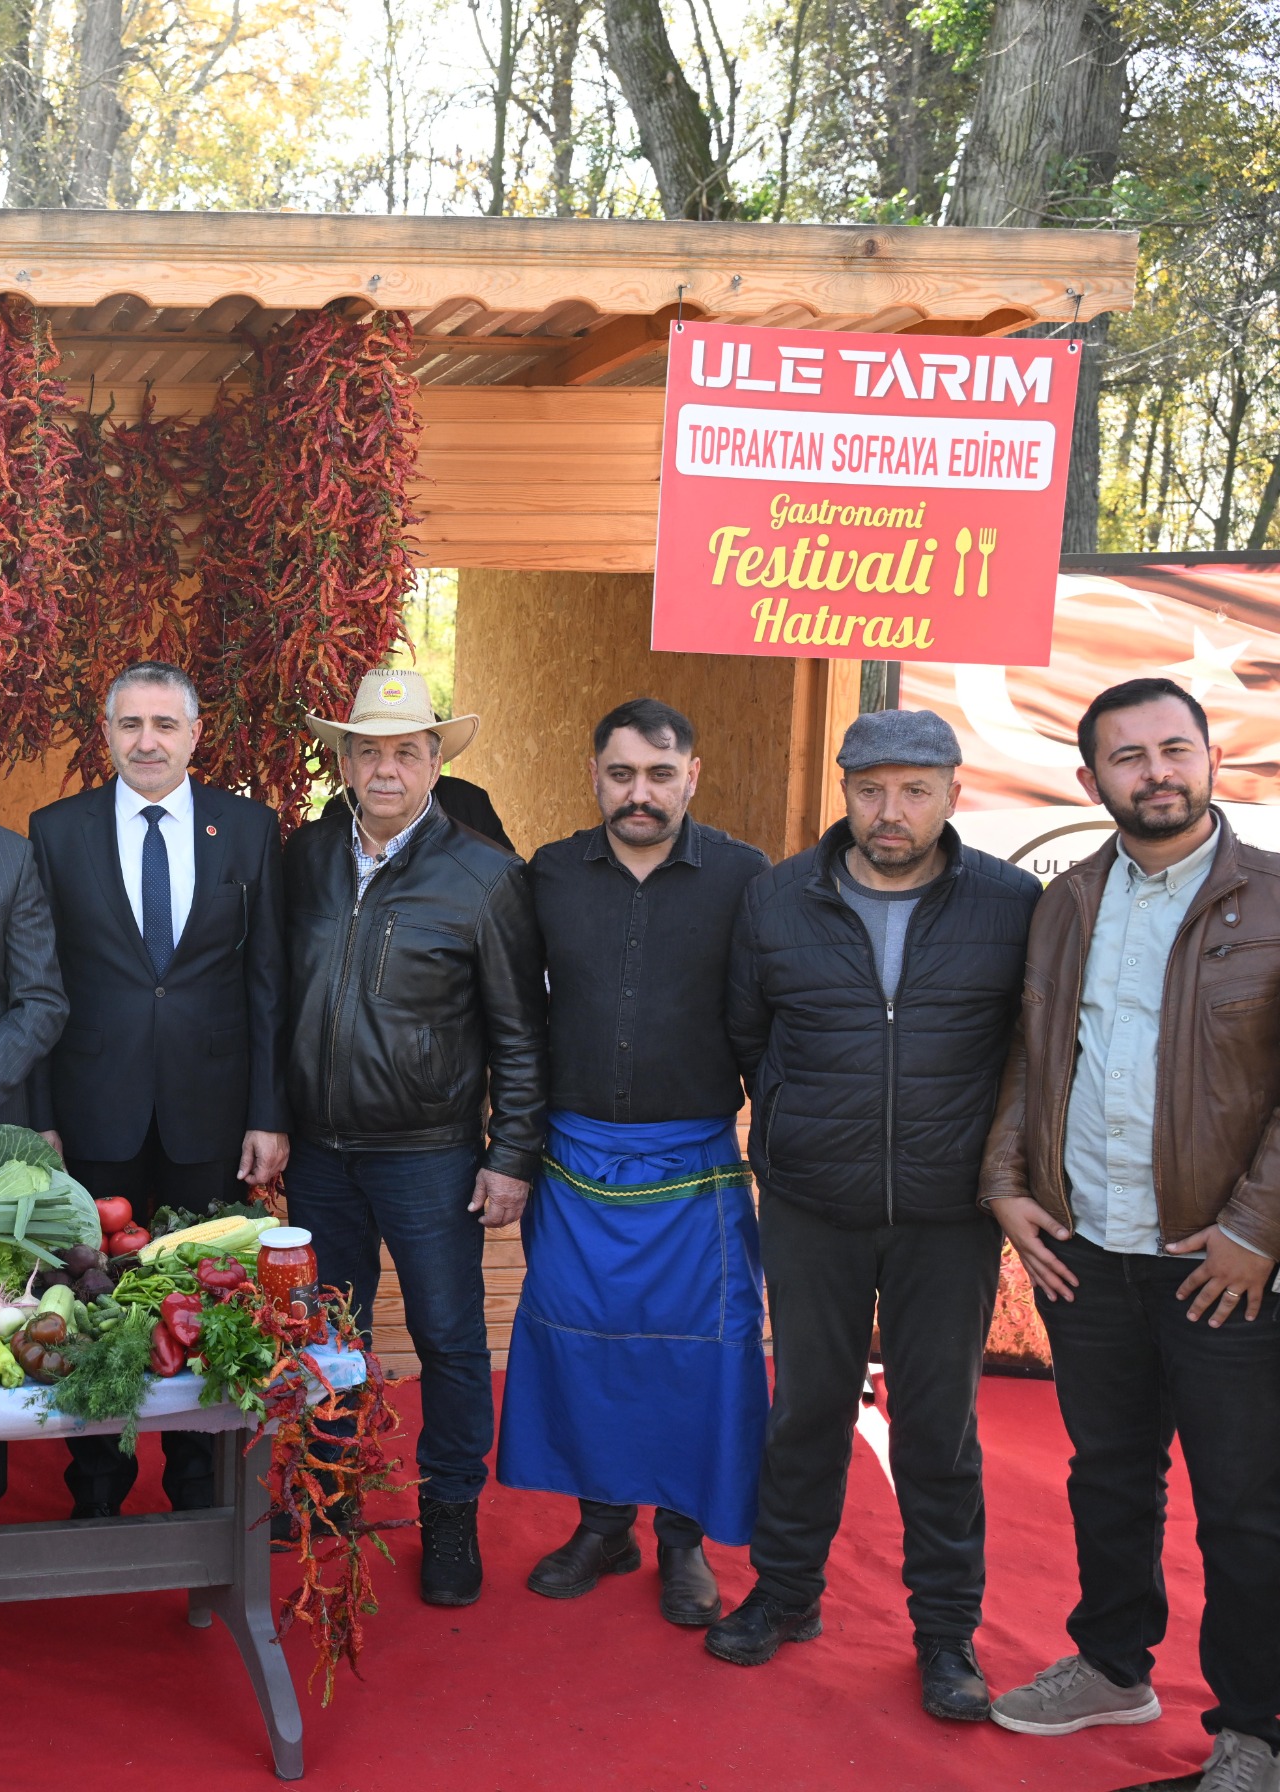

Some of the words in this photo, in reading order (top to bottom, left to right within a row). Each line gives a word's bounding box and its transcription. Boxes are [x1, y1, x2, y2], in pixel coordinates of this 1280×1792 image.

[690, 339, 825, 395] ULE
[838, 347, 1053, 407] TARIM
[688, 424, 824, 471] TOPRAKTAN
[831, 433, 939, 476] SOFRAYA
[947, 430, 1041, 480] EDİRNE
[770, 493, 927, 530] Gastronomi
[708, 525, 939, 595] Festivali
[749, 597, 935, 650] Hatırası
